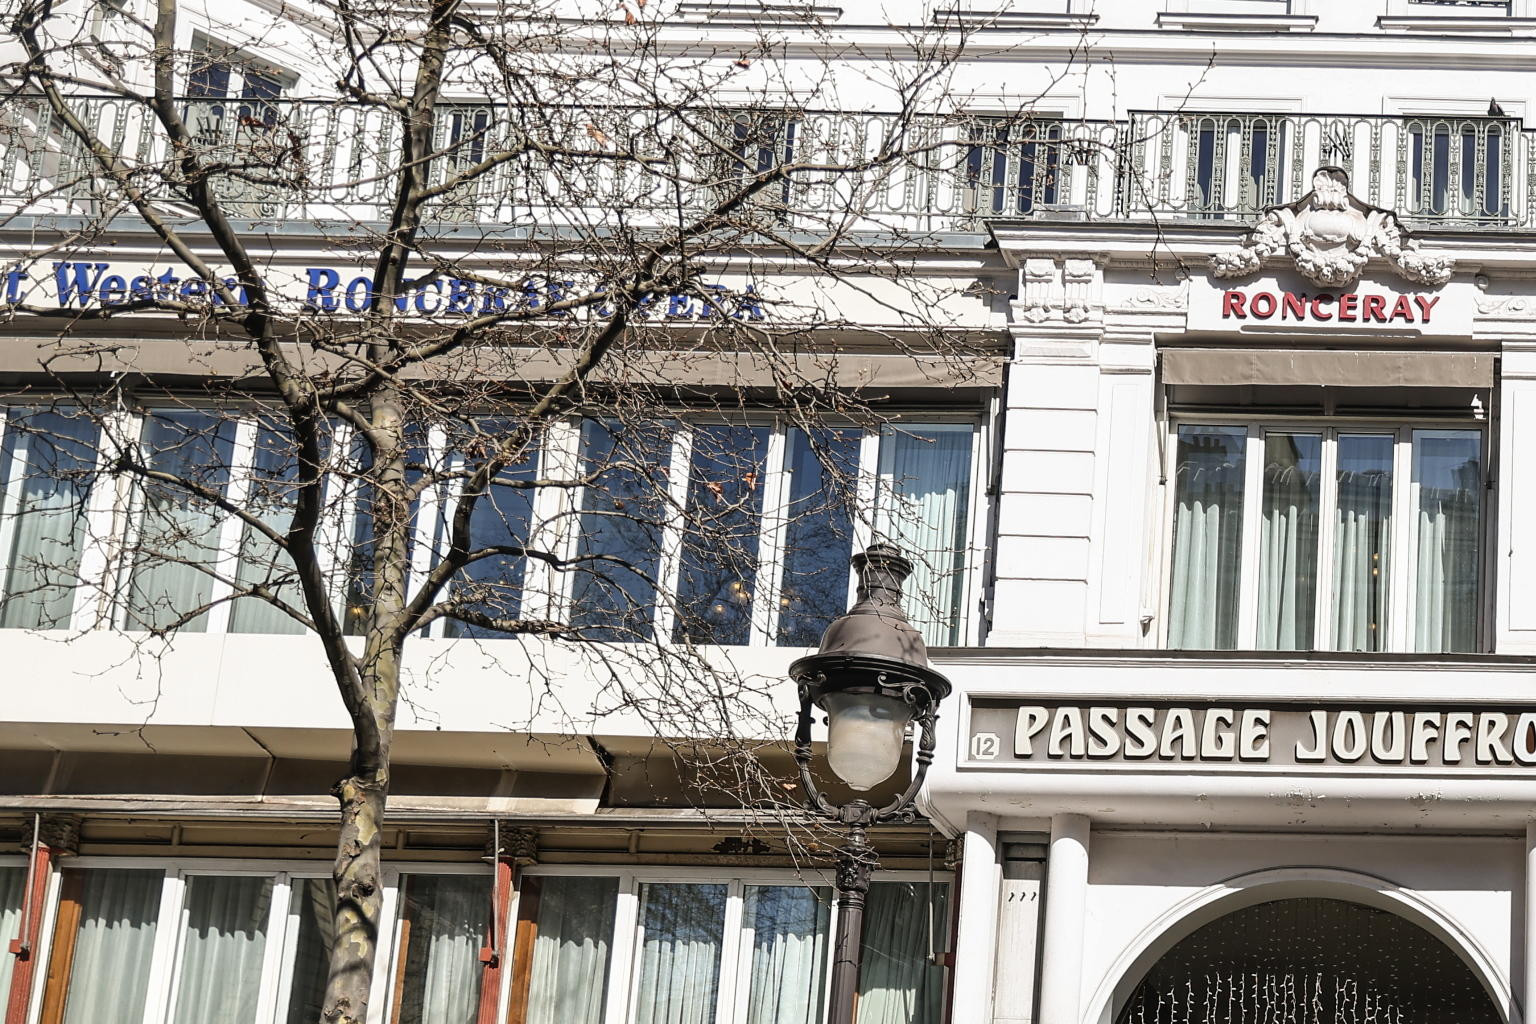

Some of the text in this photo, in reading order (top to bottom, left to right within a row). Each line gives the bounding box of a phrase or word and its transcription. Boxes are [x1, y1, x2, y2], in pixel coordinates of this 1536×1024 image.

[1222, 291, 1440, 323] RONCERAY
[976, 737, 995, 757] 12
[1014, 705, 1272, 763] PASSAGE
